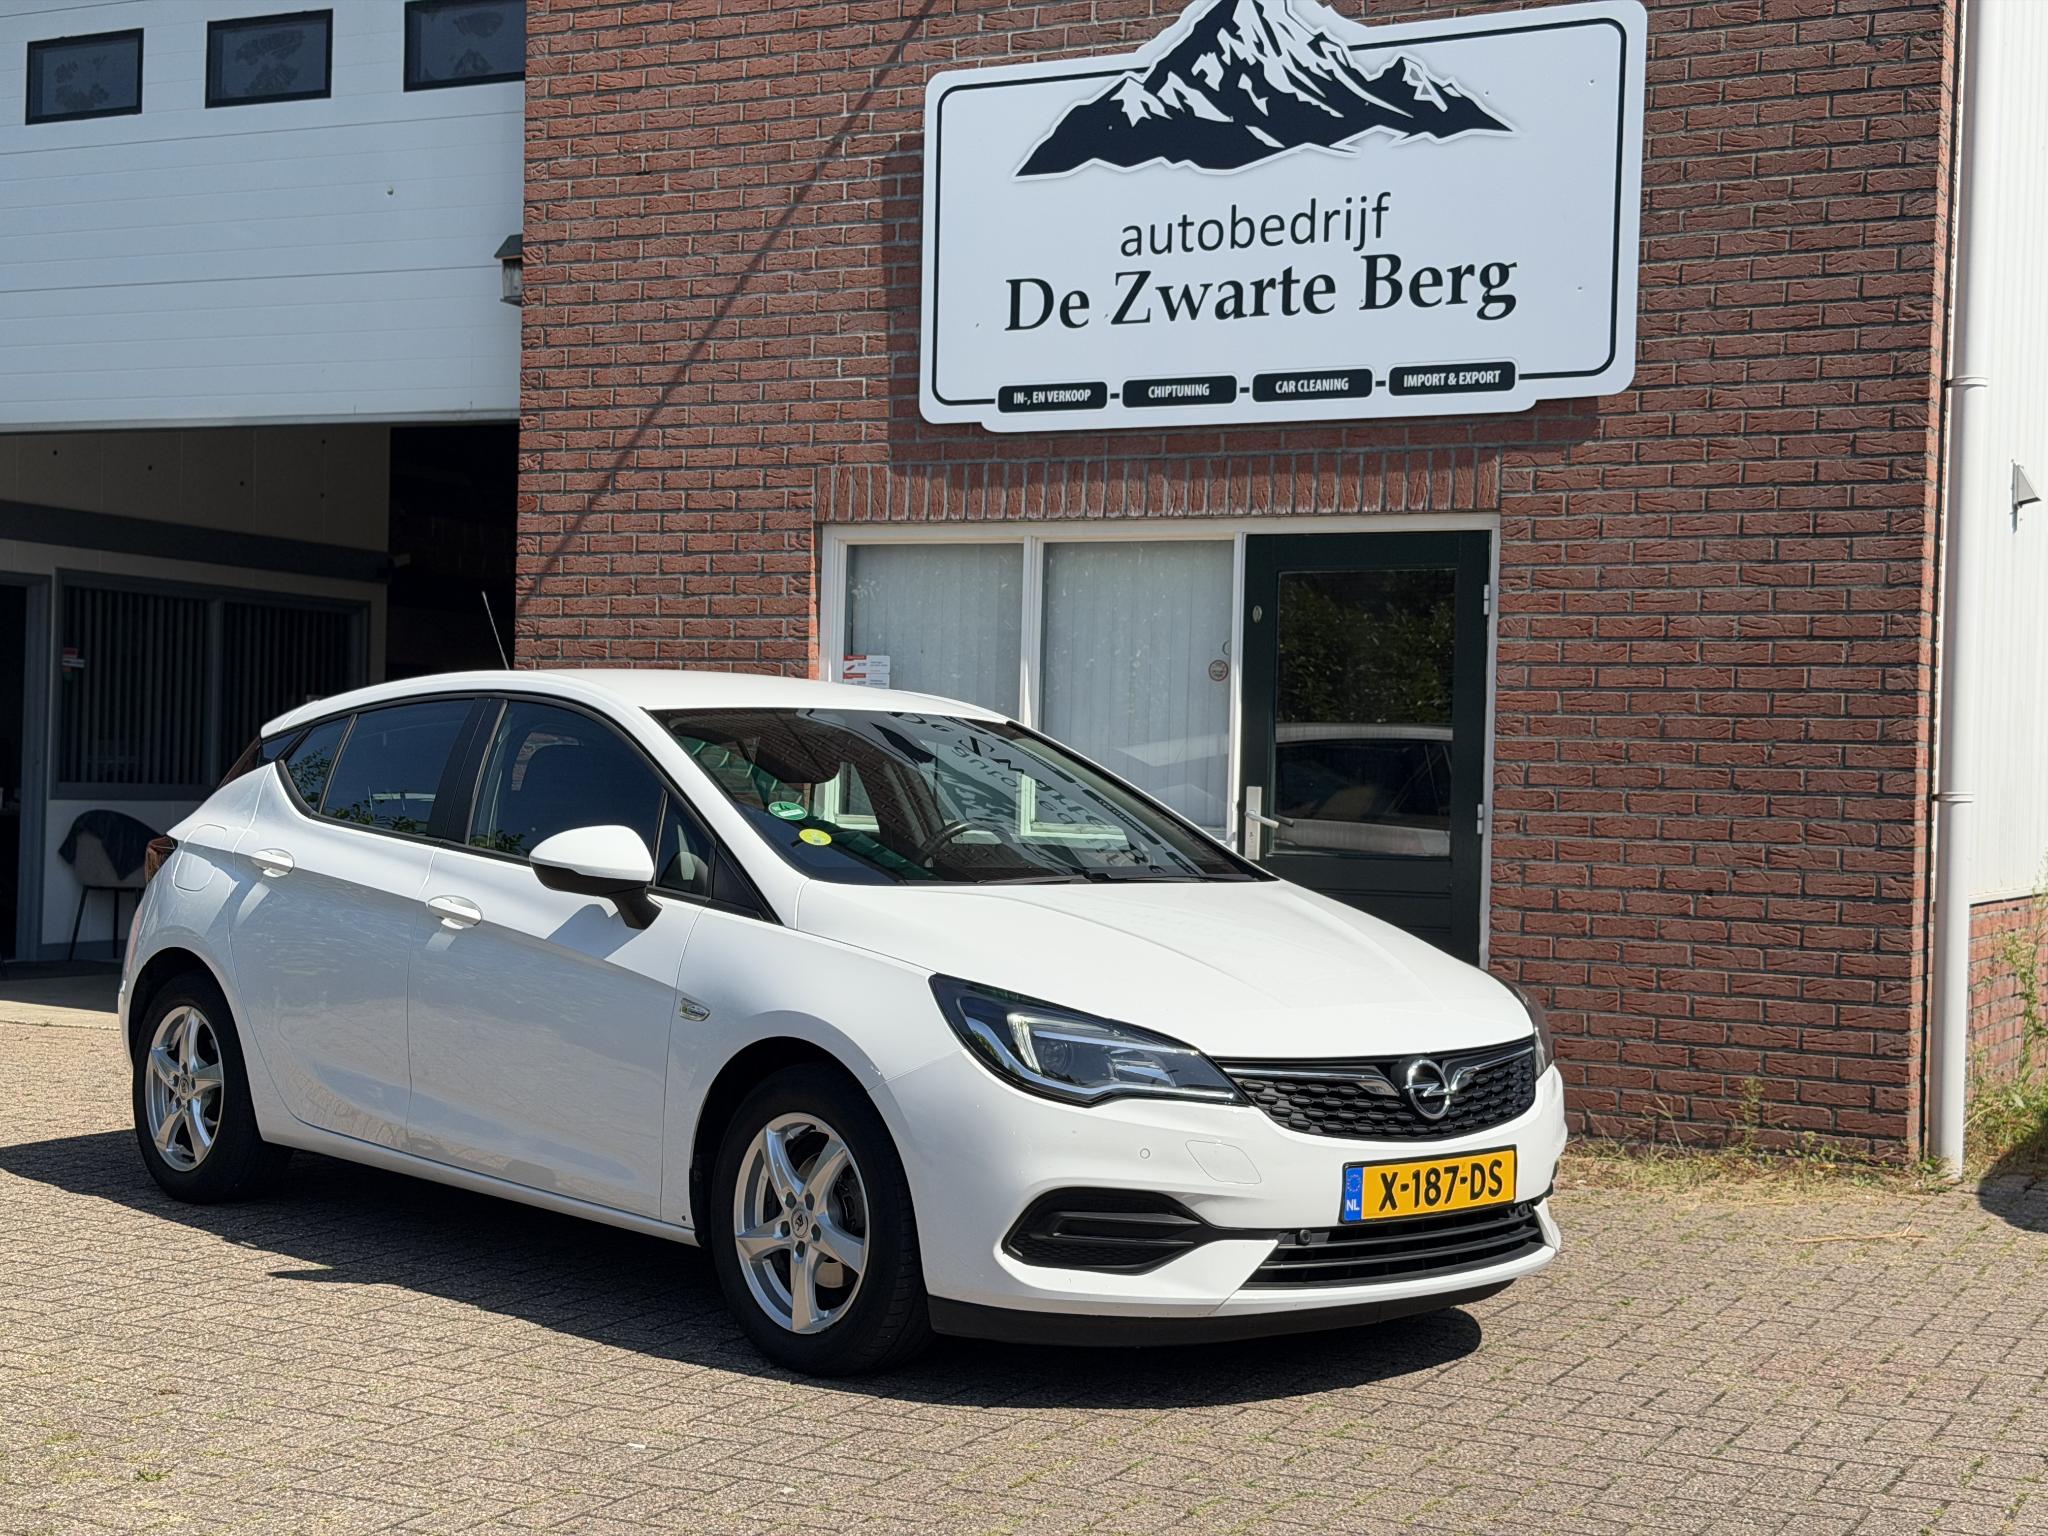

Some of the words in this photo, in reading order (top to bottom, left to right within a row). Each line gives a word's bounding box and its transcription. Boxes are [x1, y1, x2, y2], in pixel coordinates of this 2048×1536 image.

[1120, 191, 1392, 257] autobedrijf
[1004, 277, 1090, 331] De
[1110, 265, 1336, 325] Zwarte
[1359, 253, 1518, 321] Berg
[1275, 380, 1296, 394] CAR
[1297, 377, 1349, 393] CLEANING
[1403, 372, 1447, 388] IMPORT
[1447, 372, 1458, 386] &
[1458, 369, 1502, 385] EXPORT
[1032, 391, 1046, 404] EN
[1046, 388, 1092, 403] VERKOOP
[1148, 383, 1210, 399] CHIPTUNING
[1378, 1158, 1503, 1212] X-187-DS
[1346, 1200, 1360, 1211] NL
